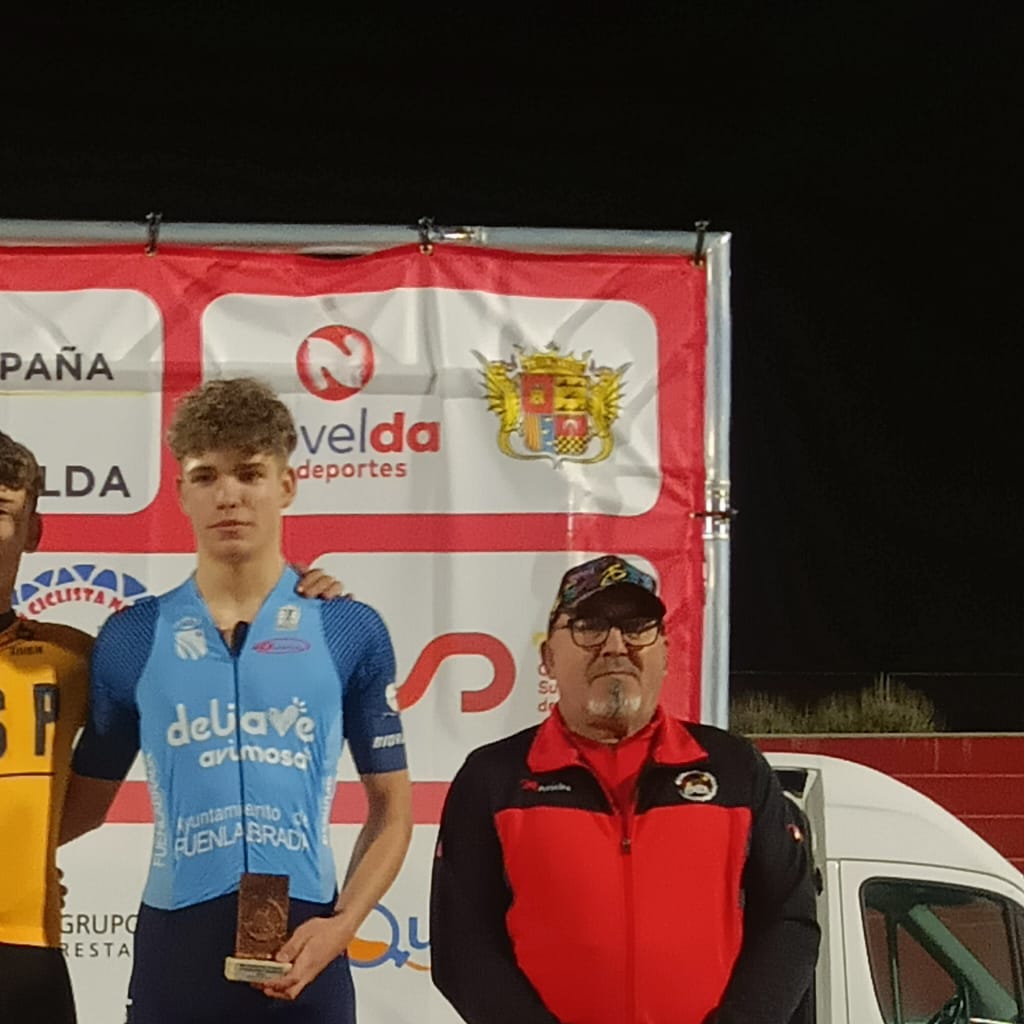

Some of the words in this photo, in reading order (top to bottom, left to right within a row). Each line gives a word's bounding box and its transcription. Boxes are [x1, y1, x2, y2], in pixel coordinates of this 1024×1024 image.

[296, 408, 441, 455] velda
[296, 459, 407, 484] deportes
[28, 587, 104, 615] CICLISTA
[175, 822, 311, 858] FUENLABRADA
